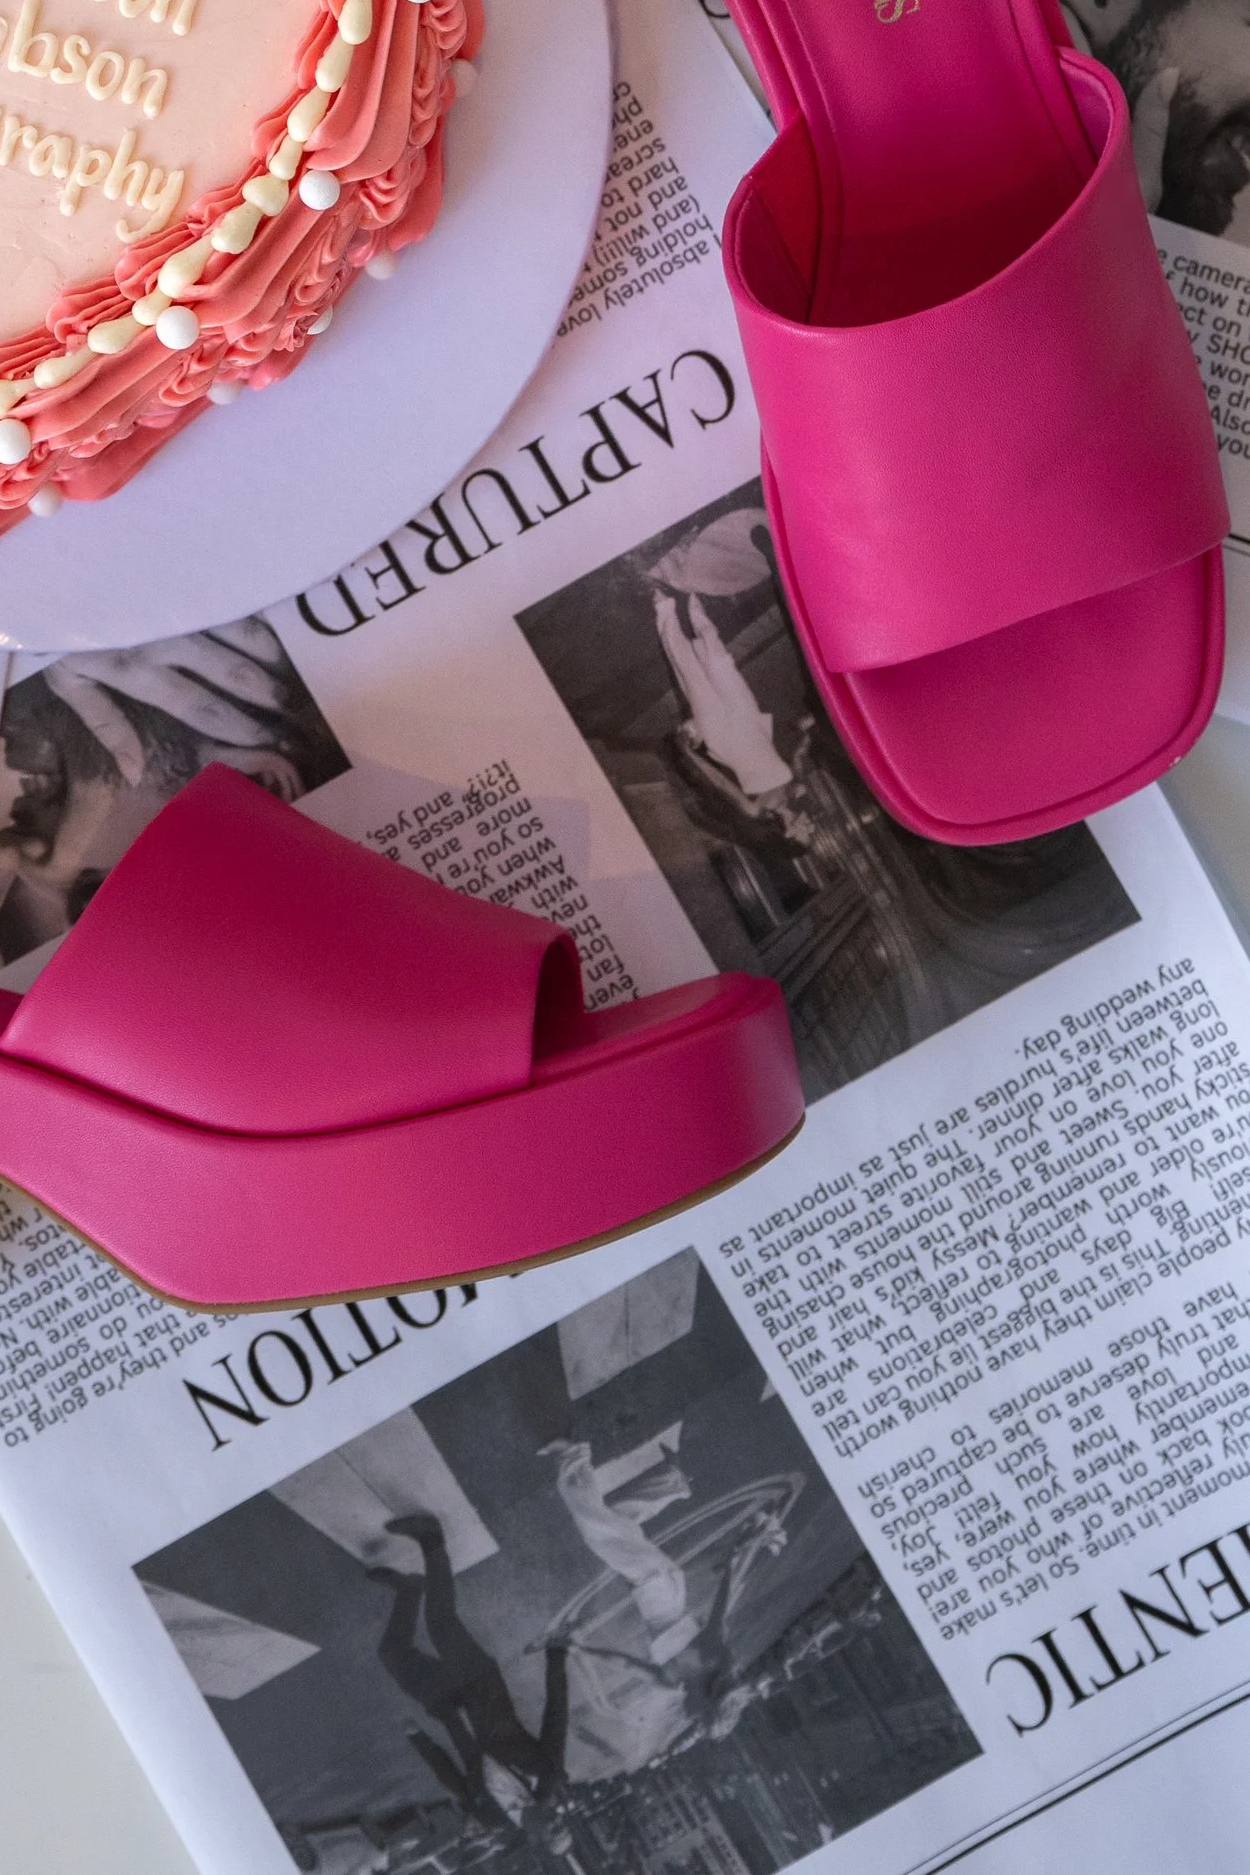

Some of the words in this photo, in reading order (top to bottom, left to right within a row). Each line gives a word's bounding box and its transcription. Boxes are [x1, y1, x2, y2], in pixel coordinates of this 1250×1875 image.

[625, 156, 679, 199] hard
[646, 175, 688, 212] and
[600, 187, 625, 209] to
[602, 201, 644, 233] not
[650, 193, 701, 235] (and
[626, 214, 714, 269] holding
[594, 240, 710, 311] absolutely
[296, 349, 736, 636] CAPTURED
[406, 773, 521, 851] progresses
[411, 791, 454, 829] and
[475, 797, 532, 837] more
[517, 816, 544, 839] so
[420, 836, 463, 875] and
[496, 837, 557, 877] when
[1059, 979, 1156, 1038] wedding
[1107, 1025, 1174, 1065] walks
[973, 1058, 1058, 1113] hurdles
[1052, 1058, 1103, 1099] after
[934, 1107, 970, 1135] are
[887, 1122, 934, 1168] just
[923, 1138, 968, 1169] The
[858, 1155, 884, 1179] as
[860, 1159, 918, 1204] quiet
[747, 1171, 858, 1243] important
[719, 1235, 745, 1259] as
[757, 1197, 858, 1264] moments
[730, 1257, 756, 1278] in
[98, 1315, 128, 1341] do
[133, 1313, 181, 1348] that
[168, 1321, 211, 1358] and
[44, 1334, 134, 1402] happen!
[26, 1386, 89, 1434] going
[3, 1426, 30, 1448] to
[1136, 1508, 1163, 1530] in
[1048, 1554, 1080, 1579] So
[939, 1600, 998, 1641] make
